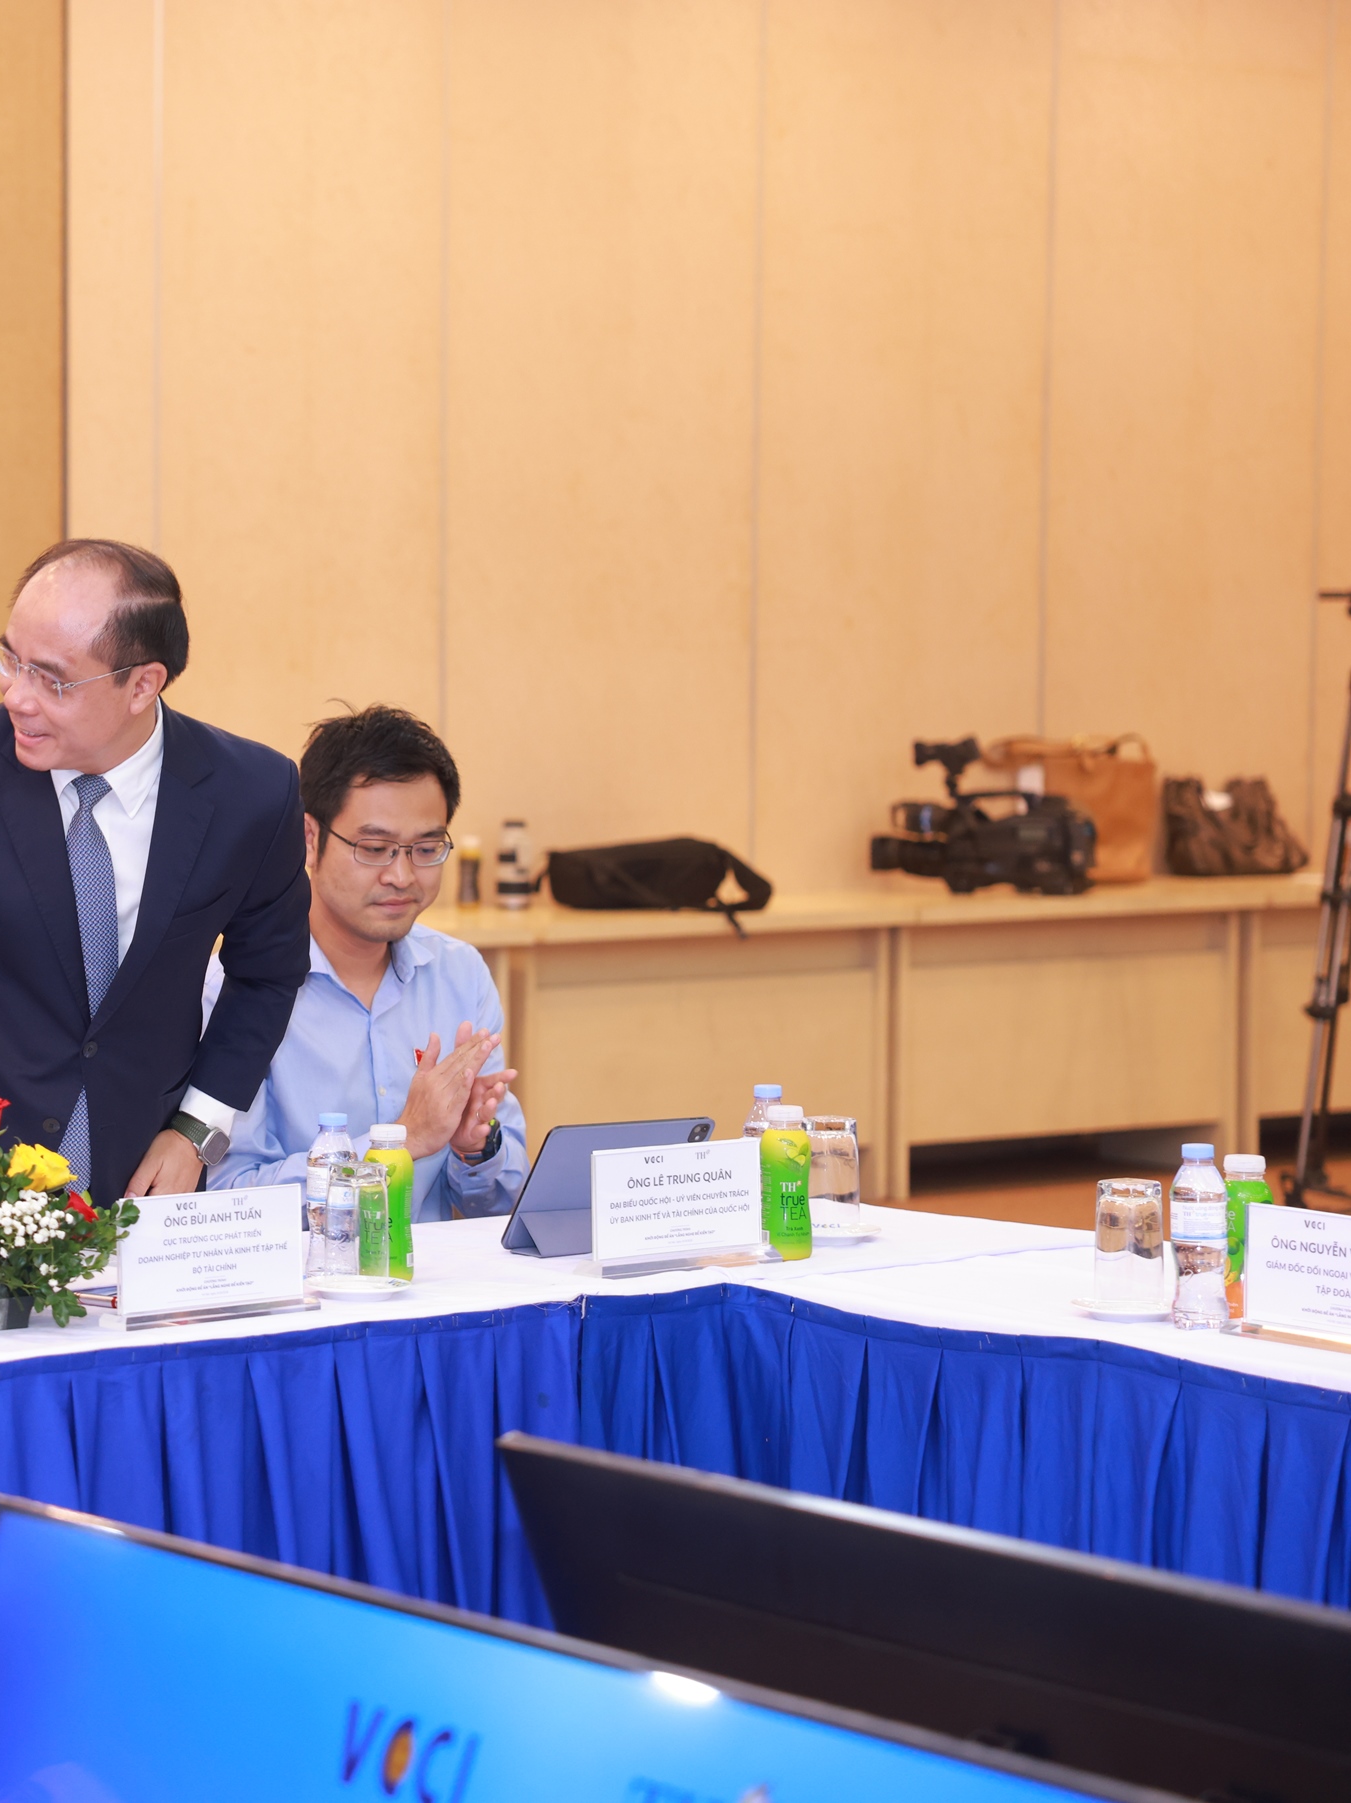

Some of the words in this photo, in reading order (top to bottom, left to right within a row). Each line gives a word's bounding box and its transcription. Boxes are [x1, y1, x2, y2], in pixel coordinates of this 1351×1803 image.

[627, 1176, 651, 1189] ÔNG
[653, 1174, 664, 1186] LÊ
[667, 1173, 701, 1186] TRUNG
[703, 1170, 732, 1183] QUÂN
[780, 1181, 796, 1192] TH
[610, 1202, 622, 1210] ĐẠI
[638, 1196, 658, 1207] QUỐC
[659, 1196, 671, 1205] HỘI
[686, 1192, 701, 1202] VIÊN
[702, 1190, 728, 1200] CHUYÊN
[729, 1189, 749, 1197] TRÁCH
[780, 1193, 805, 1205] true
[164, 1215, 188, 1228] ÔNG
[191, 1213, 207, 1225] BÙI
[210, 1212, 232, 1223] ANH
[234, 1207, 262, 1221] TUẤN
[620, 1215, 634, 1223] BAN
[635, 1214, 652, 1222] KINH
[653, 1210, 661, 1219] TẾ
[662, 1210, 671, 1218] VÀ
[672, 1209, 682, 1217] TÀI
[683, 1207, 703, 1217] CHÍNH
[704, 1205, 717, 1214] CỦA
[718, 1204, 737, 1214] QUỐC
[738, 1203, 750, 1212] HỘI
[780, 1206, 807, 1220] TEA
[163, 1238, 177, 1247] CỤC
[179, 1233, 208, 1244] TRƯỞNG
[210, 1233, 223, 1242] CỤC
[225, 1231, 242, 1240] PHÁT
[243, 1229, 262, 1238] TRIỂN
[1271, 1236, 1296, 1250] ÔNG
[1300, 1241, 1347, 1257] NGUYỄN
[138, 1255, 164, 1264] DOANH
[165, 1251, 191, 1261] NGHIỆP
[193, 1250, 202, 1258] TƯ
[203, 1247, 223, 1257] NHÂN
[224, 1247, 233, 1255] VÀ
[235, 1245, 251, 1254] KINH
[252, 1242, 260, 1252] TẾ
[261, 1243, 274, 1252] TẬP
[275, 1240, 287, 1250] THỂ
[192, 1264, 202, 1274] BỘ
[204, 1264, 214, 1273] TÀI
[216, 1263, 237, 1272] CHÍNH
[1266, 1260, 1286, 1270] GIÁM
[1288, 1263, 1305, 1273] ĐỐC
[1307, 1265, 1321, 1275] ĐỐI
[1323, 1269, 1348, 1280] NGOẠI
[1316, 1285, 1331, 1296] TẬP
